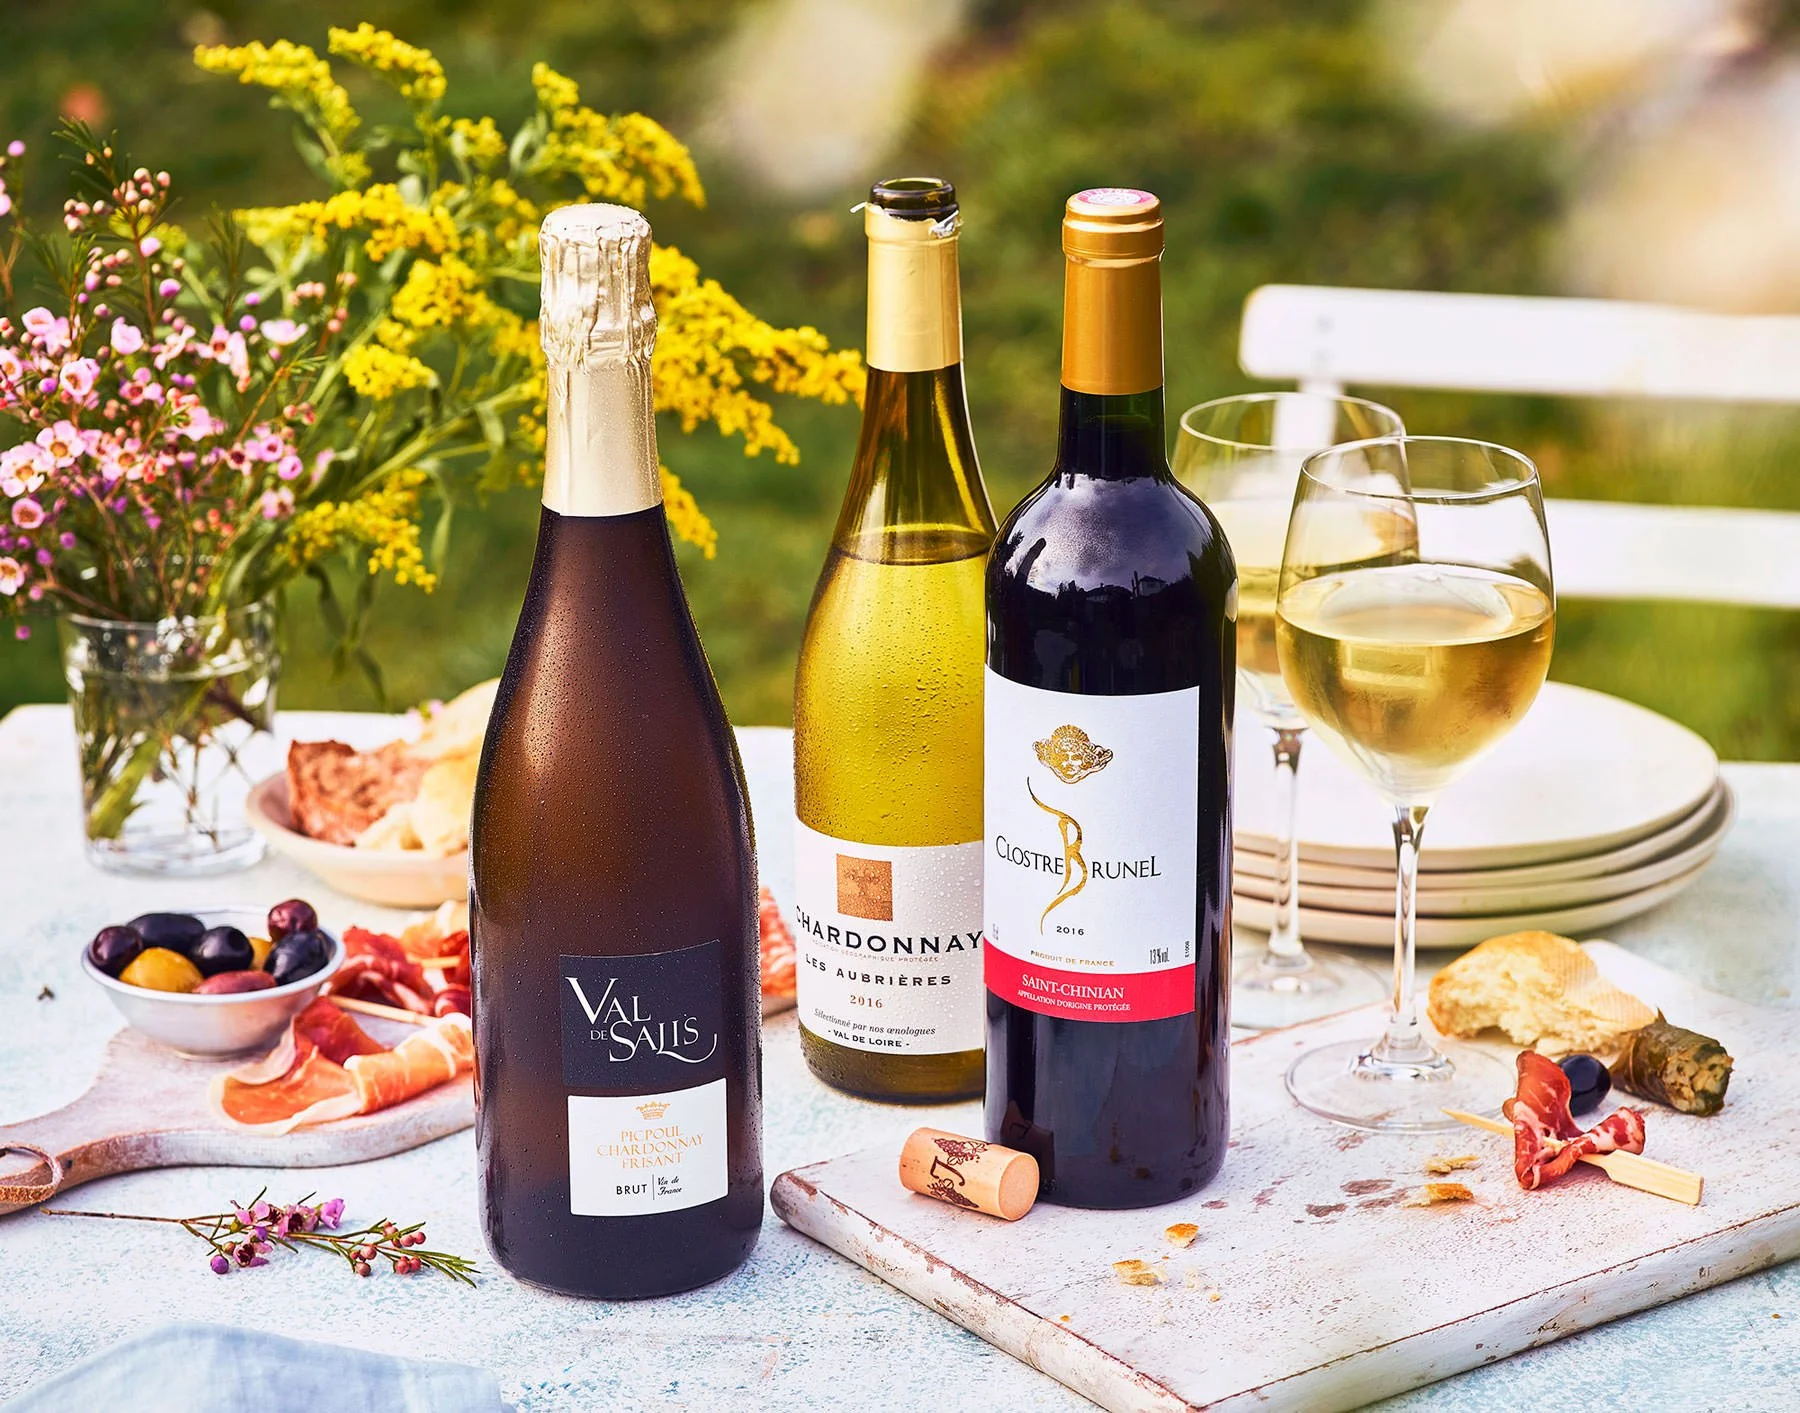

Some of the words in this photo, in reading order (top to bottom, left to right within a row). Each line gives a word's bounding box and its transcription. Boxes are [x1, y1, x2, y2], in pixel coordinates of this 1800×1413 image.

[996, 836, 1064, 875] CLOSTRE
[796, 904, 983, 955] CHARDONNAY
[1056, 925, 1085, 936] 2016
[1030, 949, 1063, 962] PRODUIT
[1065, 957, 1077, 965] DE
[1079, 959, 1116, 967] FRANCE
[805, 953, 826, 971] LES
[836, 967, 952, 986] AUBRIÈRES
[1021, 973, 1125, 999] SAINT-CHINIAN
[565, 976, 652, 1027] VAL
[849, 994, 883, 1008] 2016
[1017, 989, 1056, 1006] APPELLATION
[1056, 999, 1093, 1010] D'ORIGINE
[1093, 1001, 1131, 1011] PROTÉGÉE
[814, 1008, 851, 1027] Sélectionné
[852, 1021, 867, 1031] par
[869, 1025, 885, 1033] nos
[886, 1024, 937, 1037] œnologues
[590, 1029, 609, 1041] DE
[608, 1016, 718, 1064] SALIS
[832, 1029, 850, 1040] VAL
[852, 1034, 866, 1044] DE
[868, 1037, 903, 1048] LOIRE
[620, 1125, 683, 1143] PICPOUL
[596, 1133, 704, 1157] CHARDONNAY
[621, 1151, 683, 1169] FRISANT
[616, 1183, 648, 1196] BRUT
[657, 1176, 669, 1187] Vin
[670, 1175, 680, 1185] de
[657, 1186, 683, 1196] France
